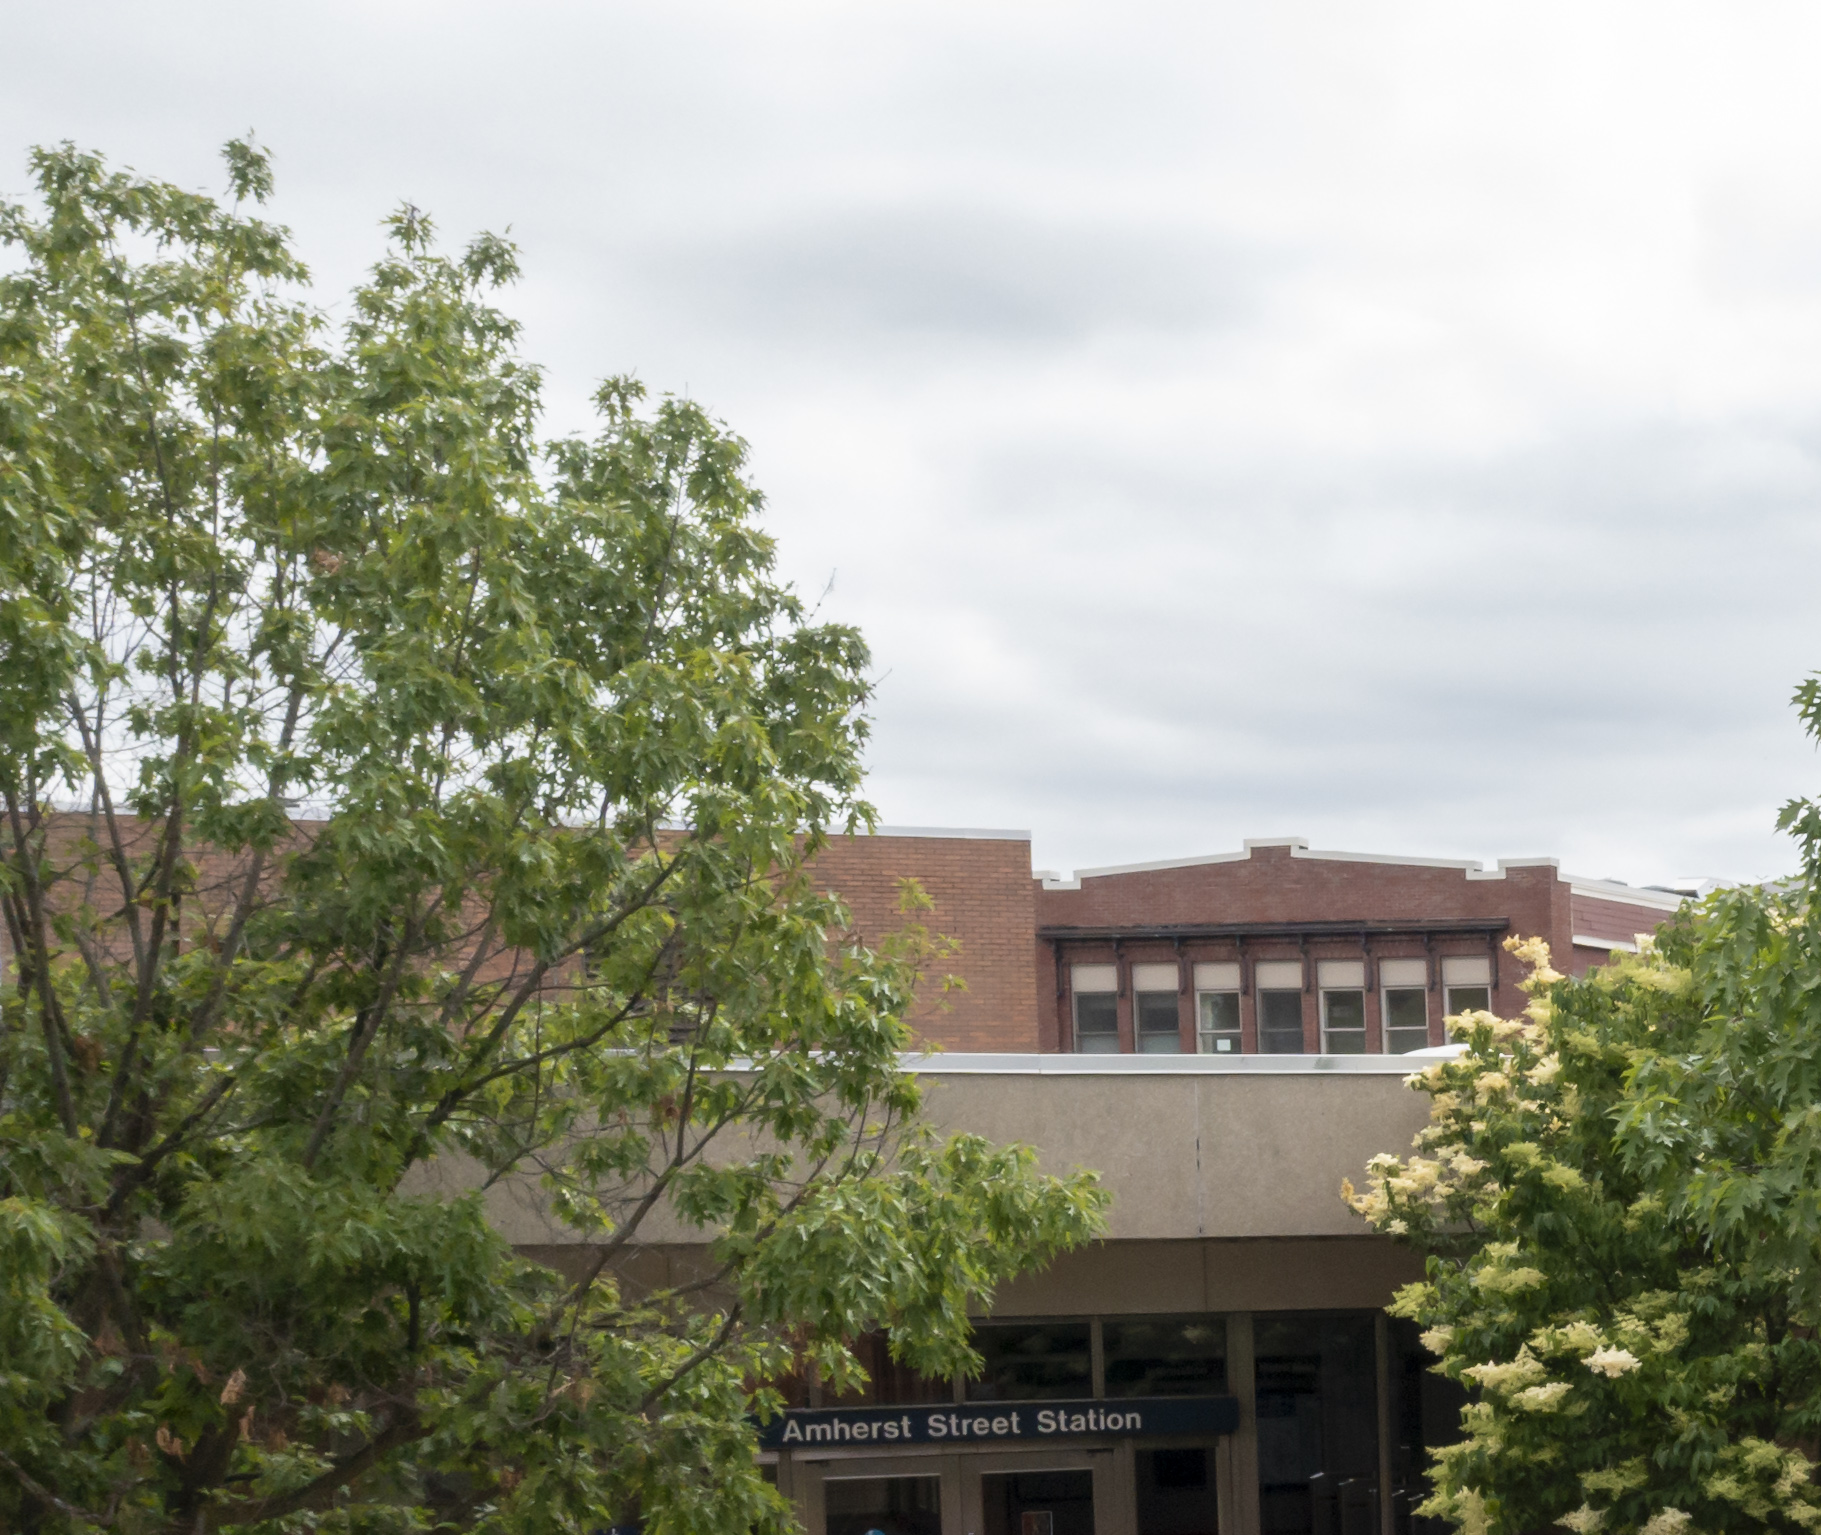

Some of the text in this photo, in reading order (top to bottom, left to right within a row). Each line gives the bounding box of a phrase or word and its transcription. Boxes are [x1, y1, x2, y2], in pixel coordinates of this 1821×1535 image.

[781, 1407, 1142, 1443] Amherst Street Station
